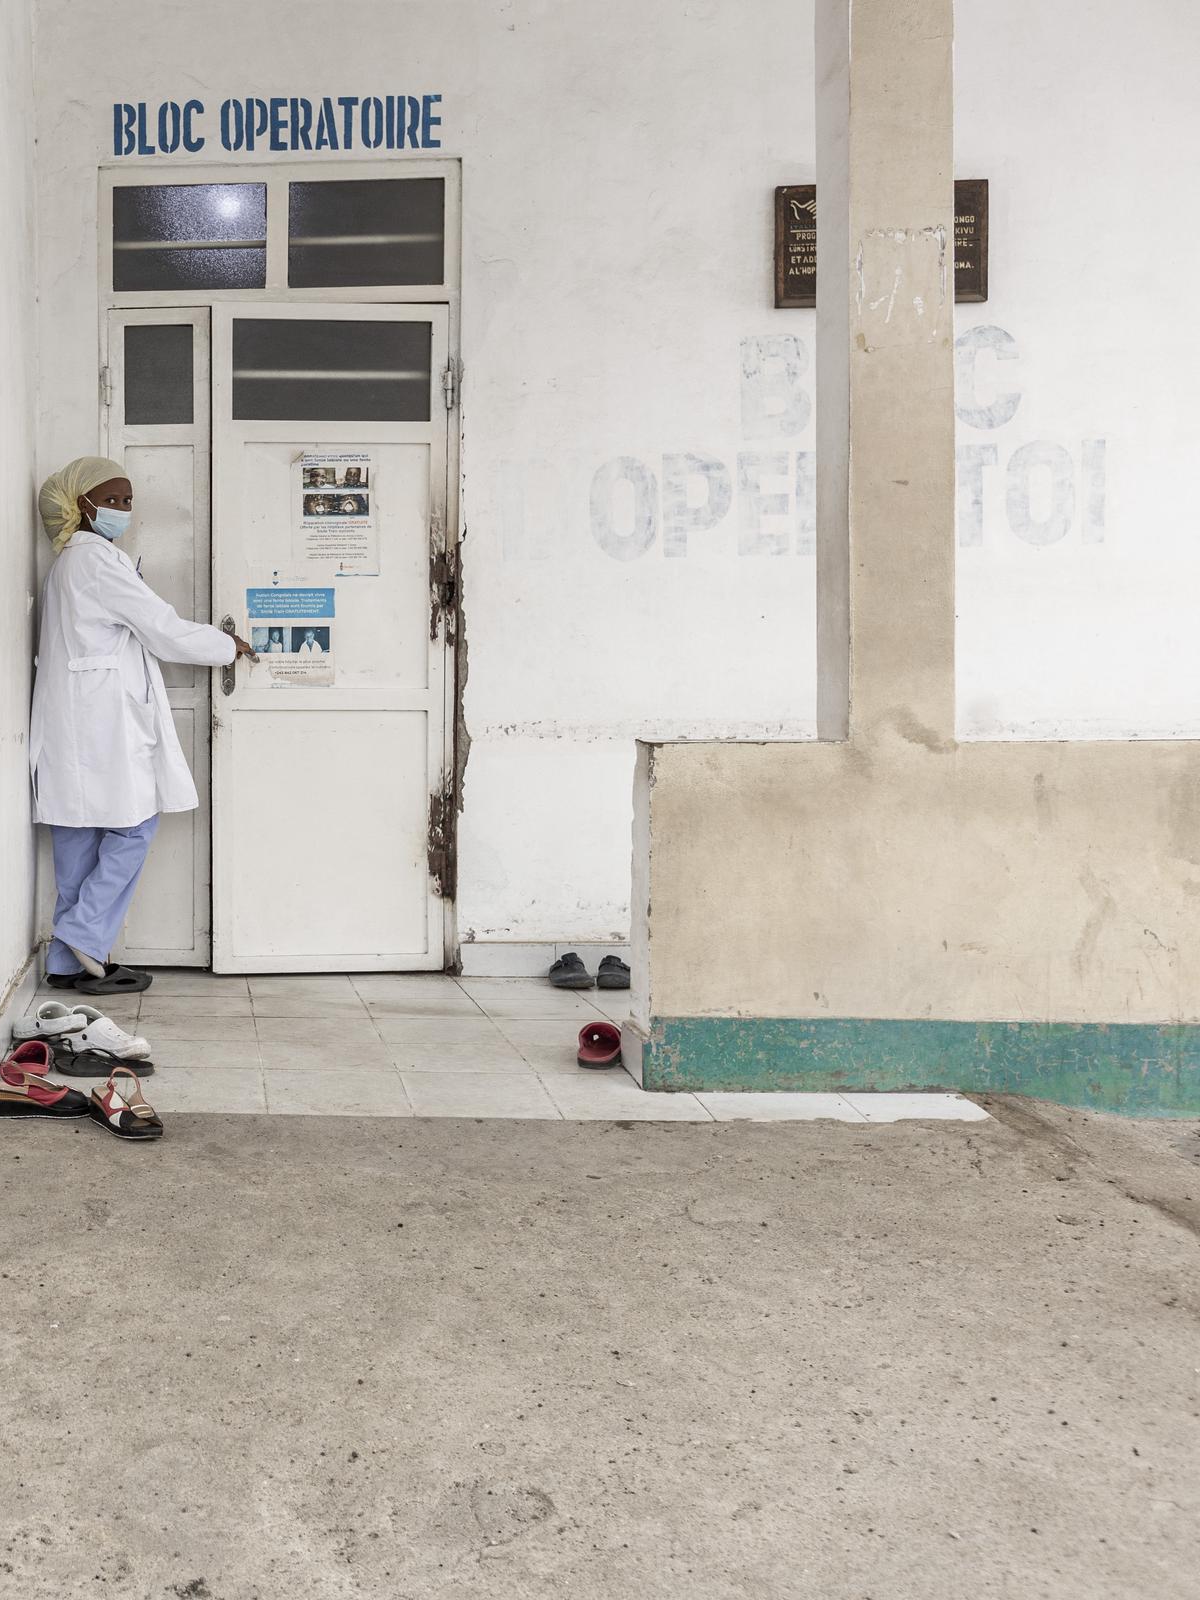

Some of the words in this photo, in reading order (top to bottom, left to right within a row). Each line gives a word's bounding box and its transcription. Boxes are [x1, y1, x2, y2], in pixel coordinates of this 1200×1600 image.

[113, 99, 205, 156] BLOC
[220, 94, 442, 152] OPERATOIRE
[954, 215, 975, 224] ONGO
[796, 232, 816, 241] PROG
[955, 226, 975, 235] KIVU
[788, 243, 816, 253] CONSTR
[791, 256, 801, 264] ET
[795, 266, 816, 275] L'HOP
[954, 261, 975, 269] OMA.
[738, 324, 1023, 442] BC
